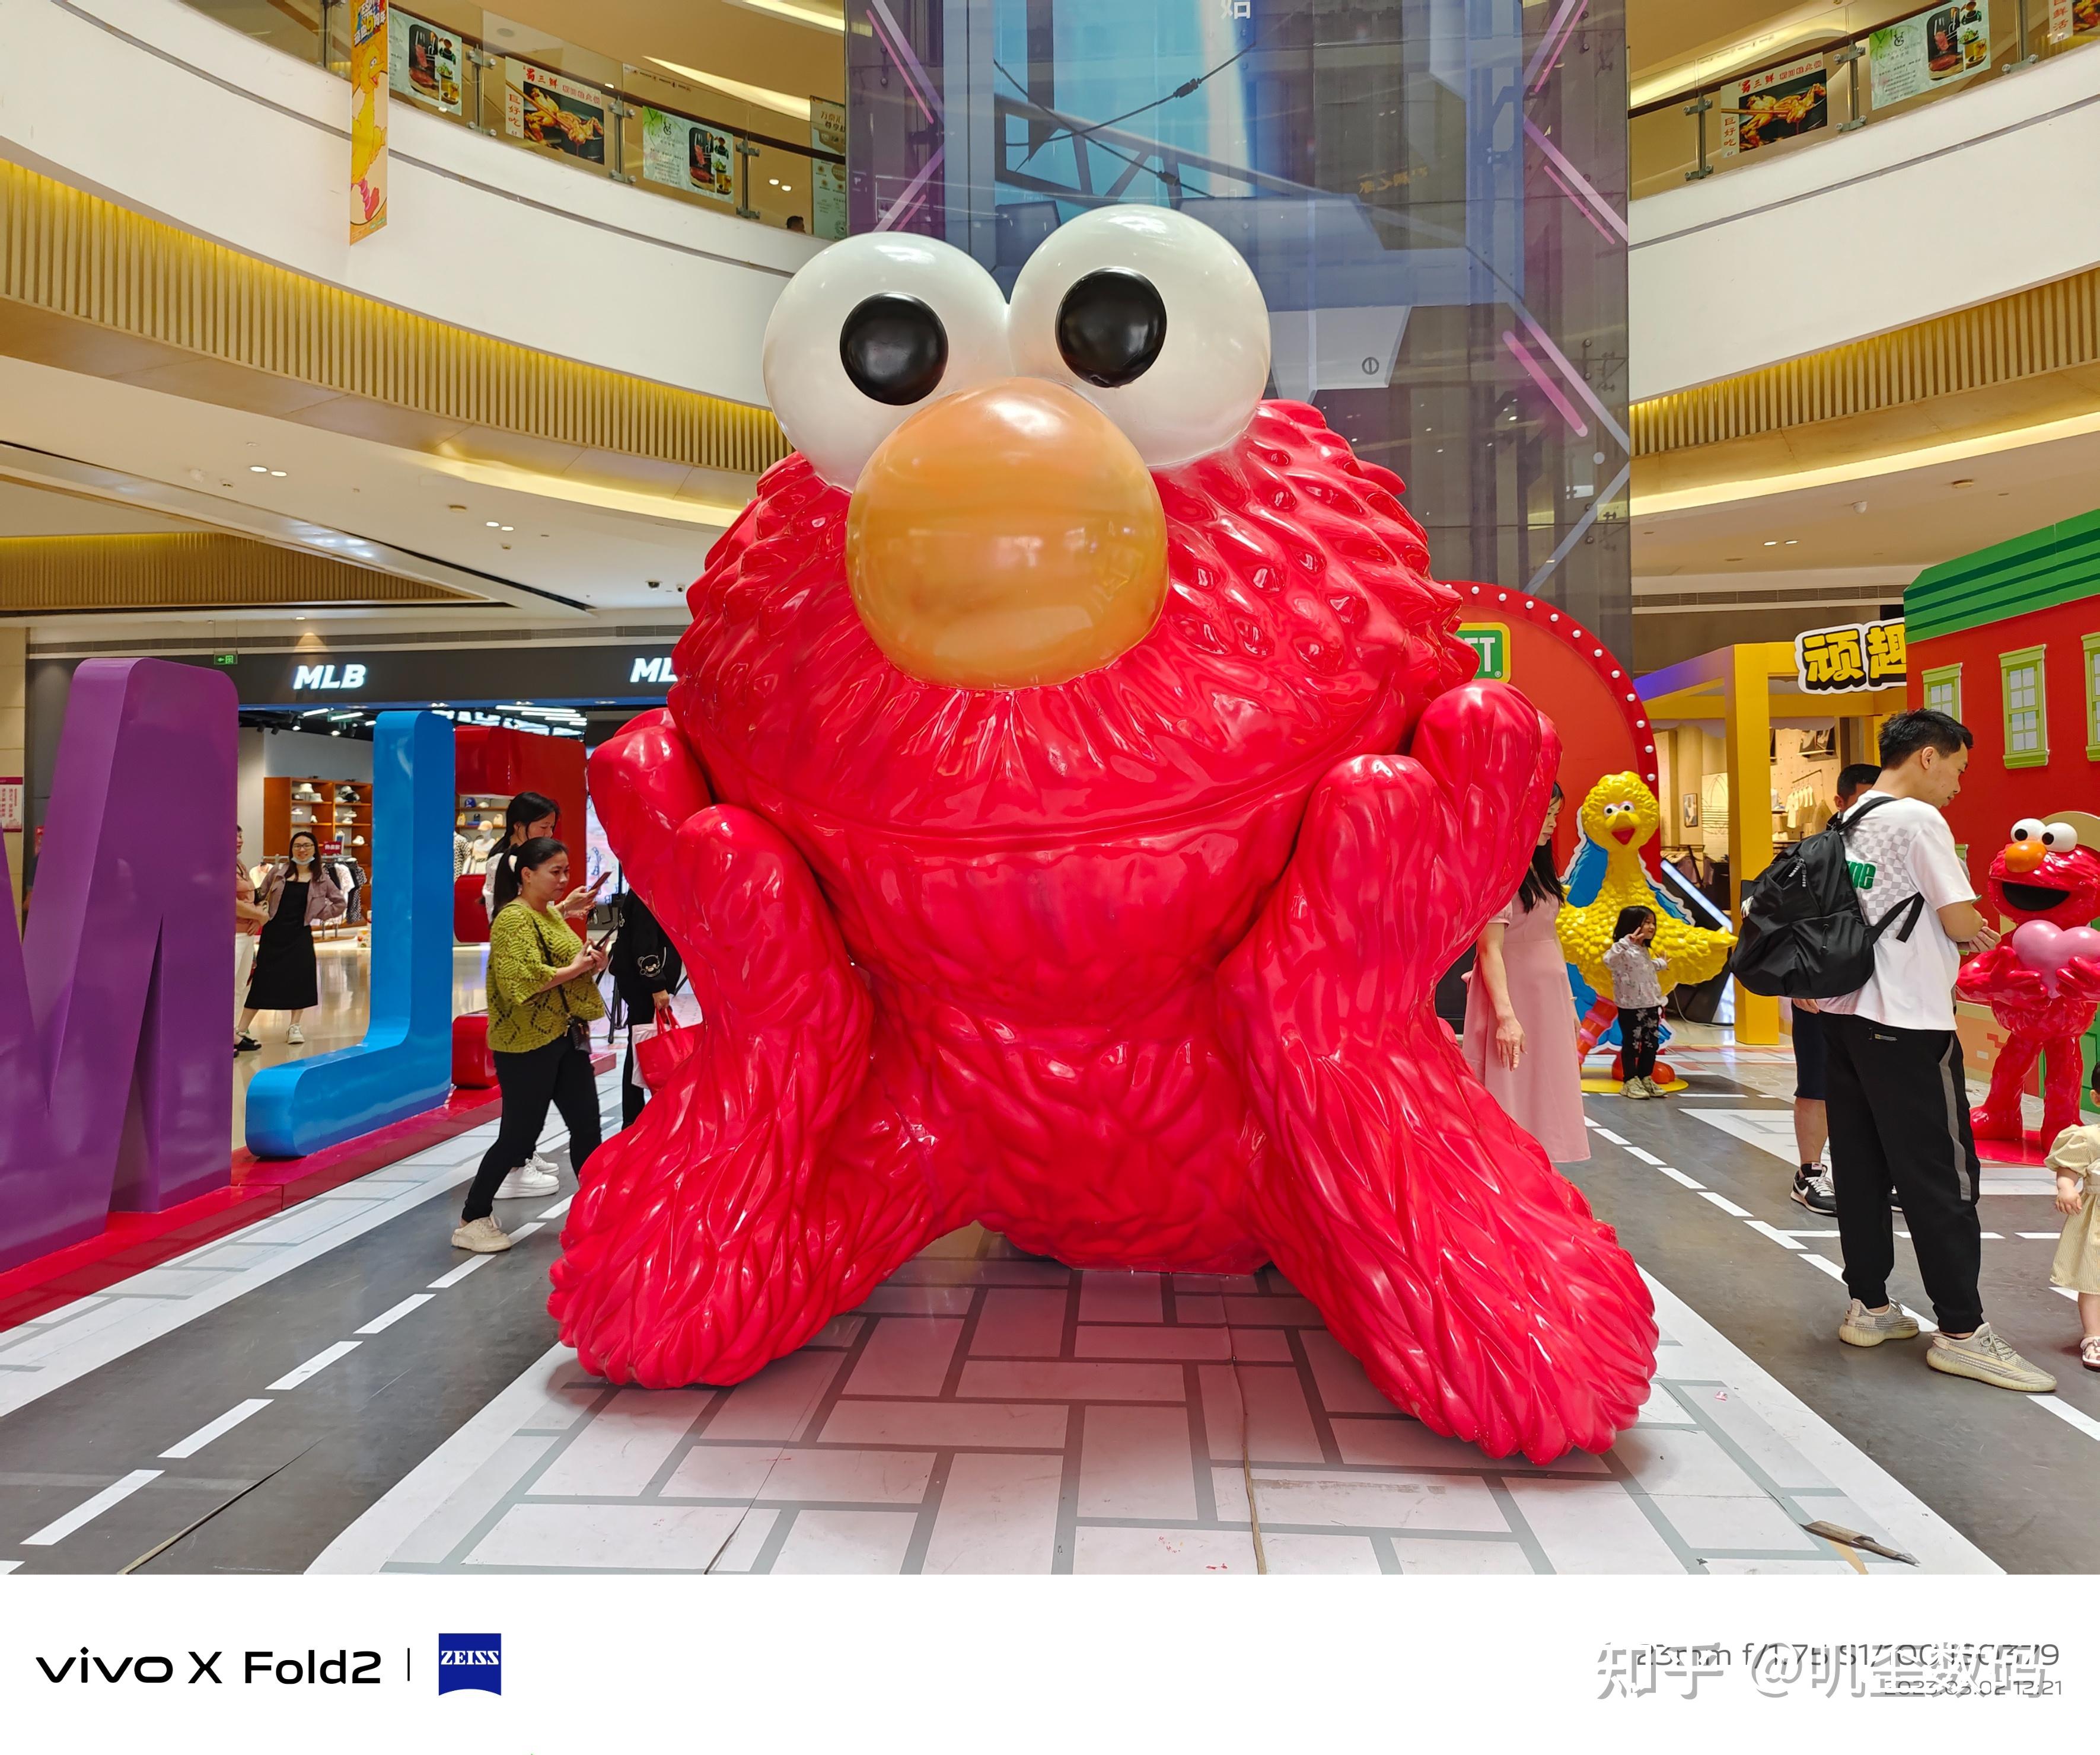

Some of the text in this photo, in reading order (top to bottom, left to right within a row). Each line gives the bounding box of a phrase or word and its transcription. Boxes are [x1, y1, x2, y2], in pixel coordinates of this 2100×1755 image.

[1741, 73, 1775, 94] 蜀三鲜
[1724, 117, 1736, 146] 巨好吃
[1464, 637, 1496, 672] T
[292, 663, 367, 690] MLB
